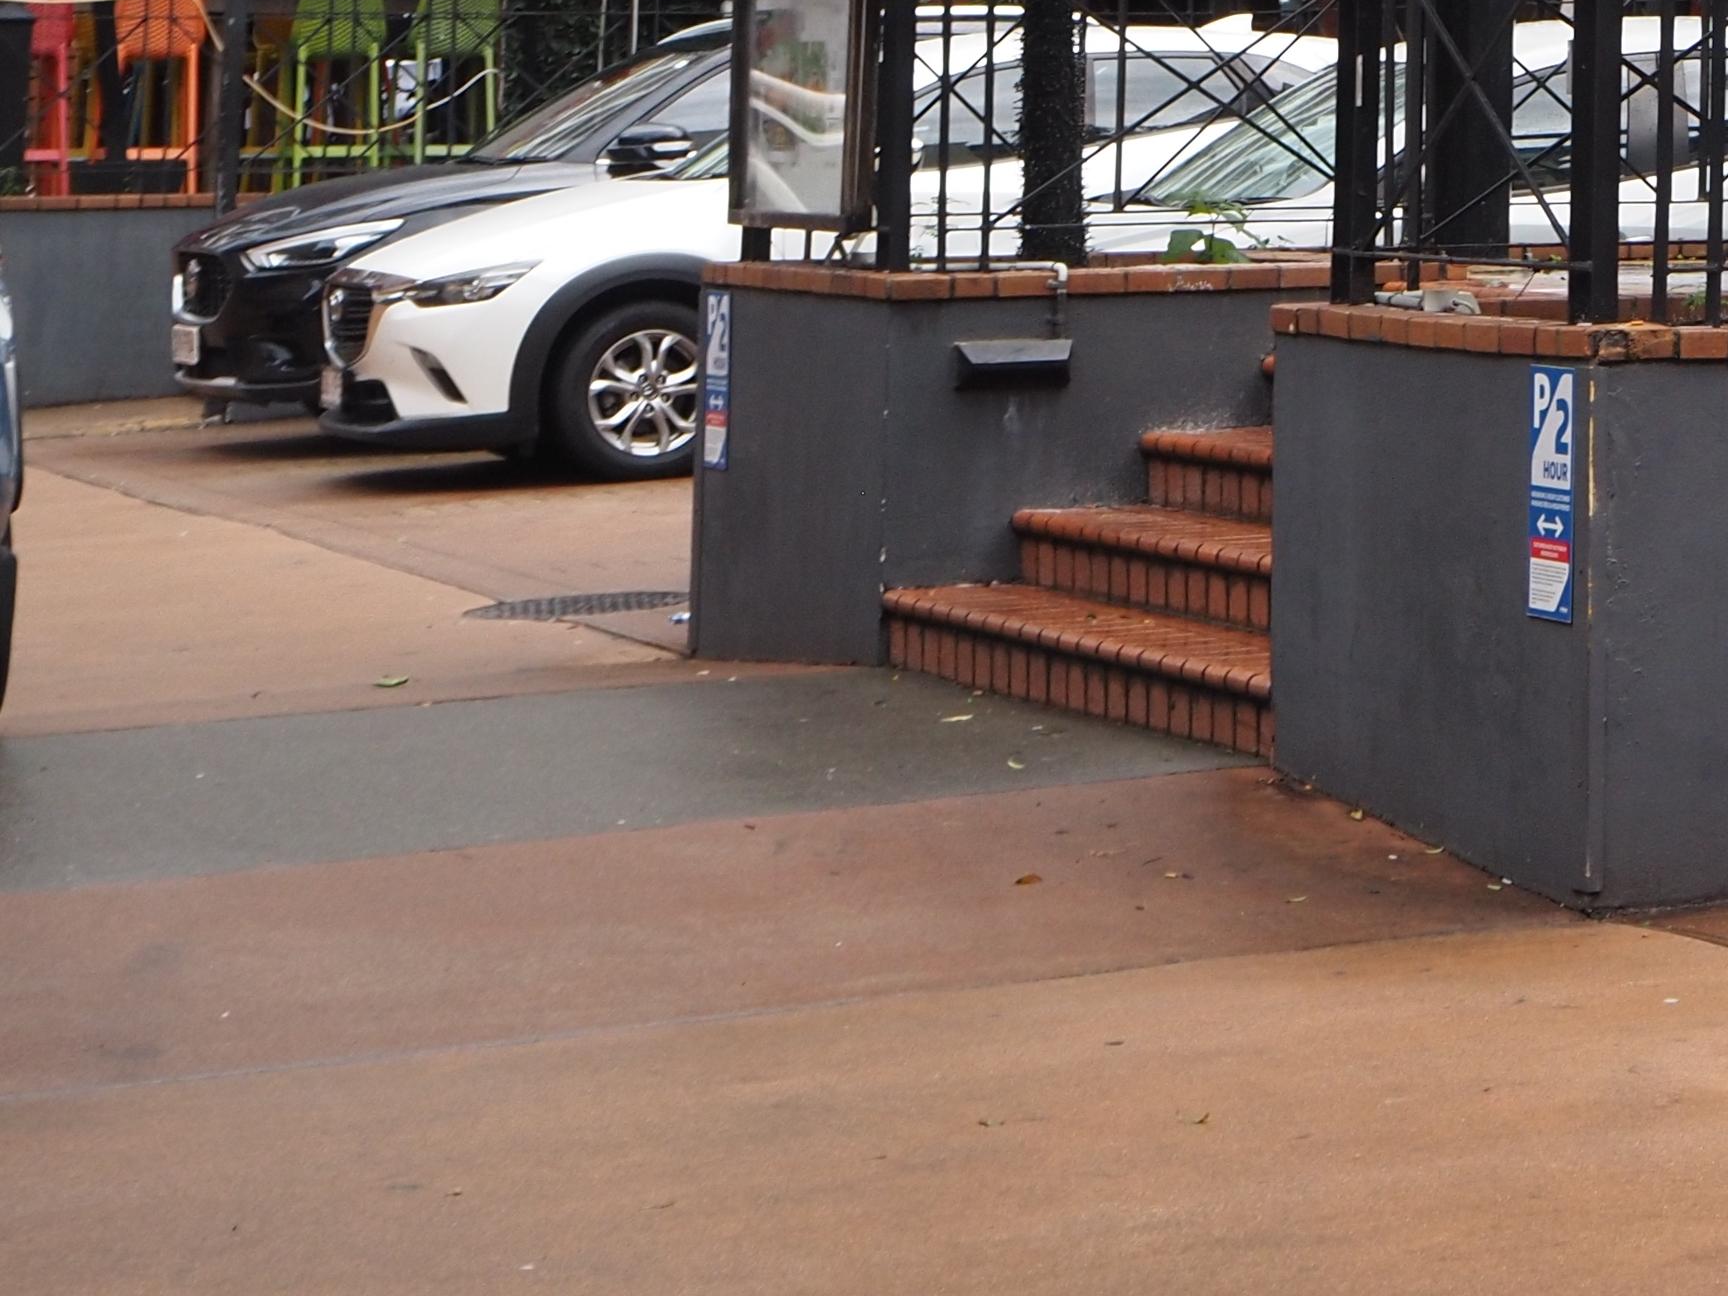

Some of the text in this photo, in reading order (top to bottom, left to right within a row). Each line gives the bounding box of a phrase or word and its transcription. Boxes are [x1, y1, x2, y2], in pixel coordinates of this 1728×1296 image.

[1534, 373, 1569, 455] P 2
[1543, 460, 1569, 482] HOUR
